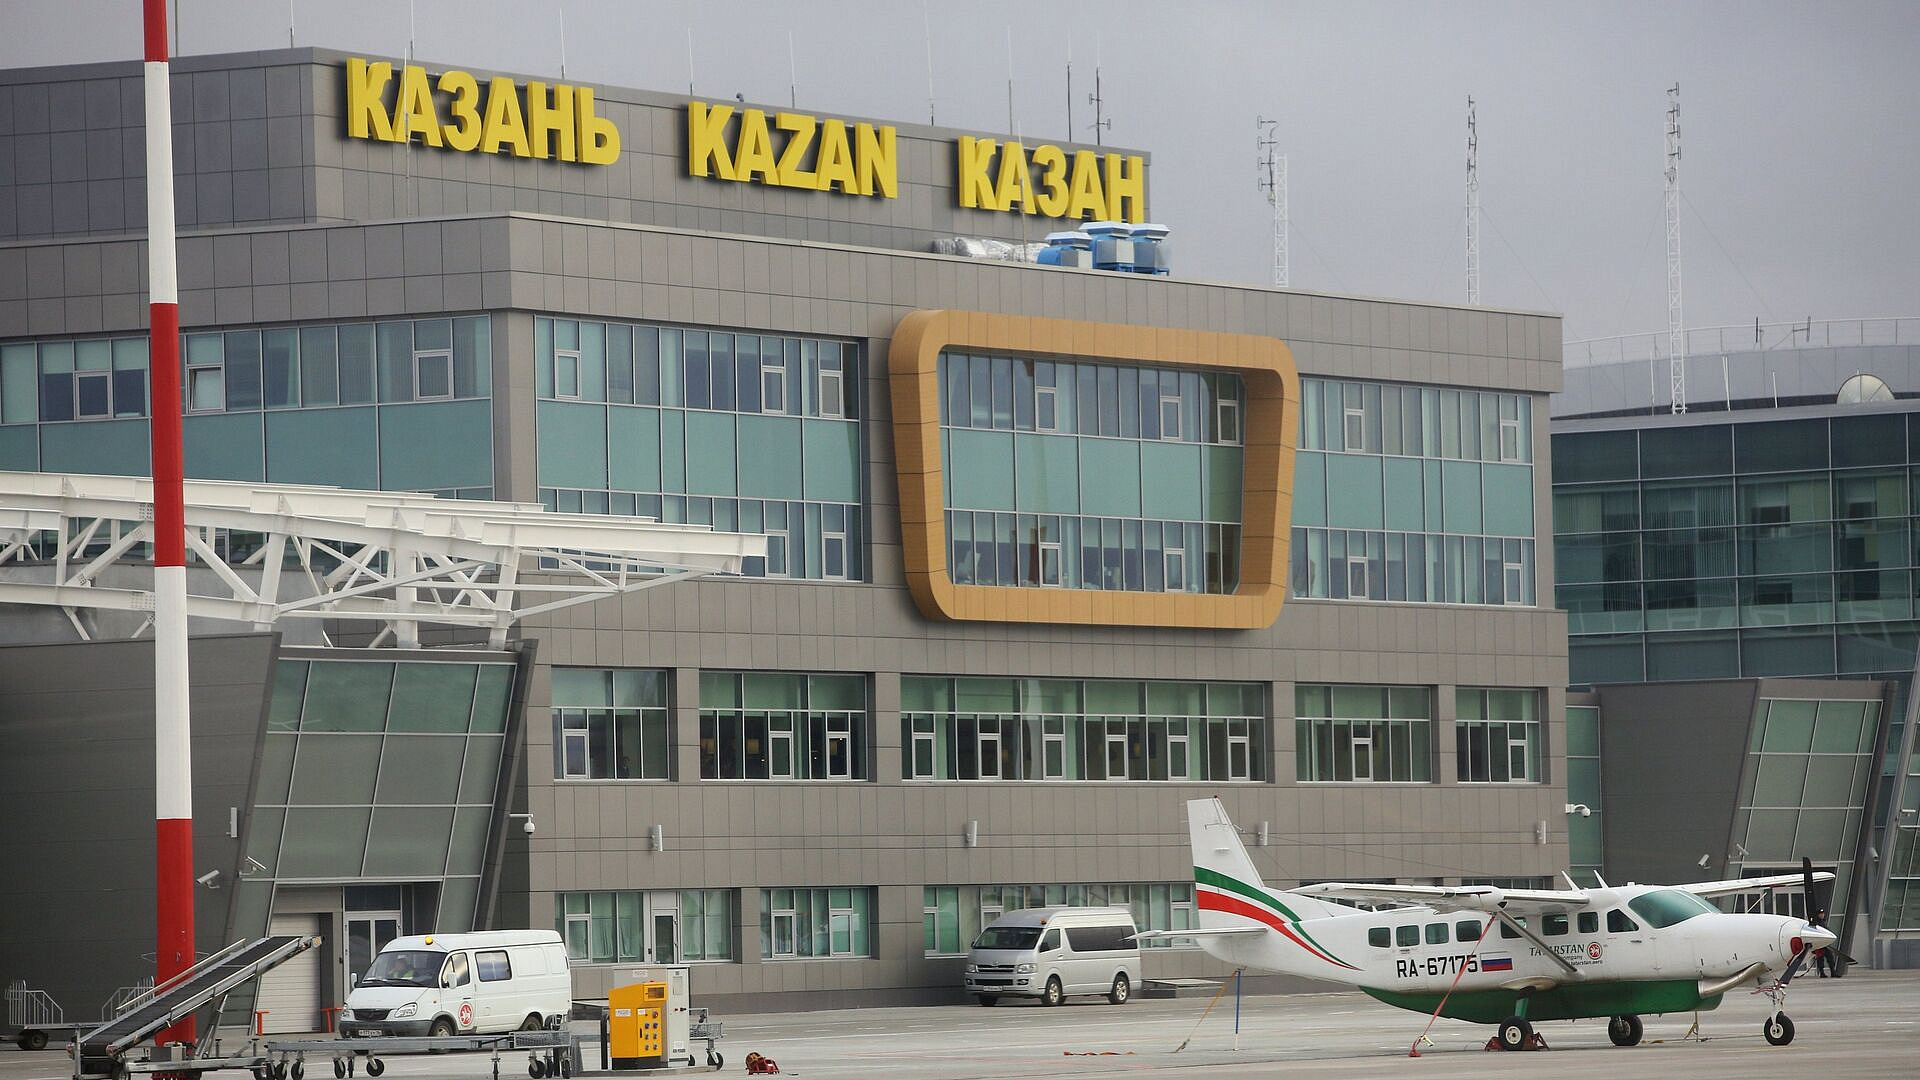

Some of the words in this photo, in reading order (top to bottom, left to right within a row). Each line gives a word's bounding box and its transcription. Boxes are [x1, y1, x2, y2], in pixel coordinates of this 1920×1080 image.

[347, 58, 620, 164] КАЗАНЬ
[688, 101, 897, 198] KAZAN
[958, 135, 1144, 224] КАЗАН
[1529, 944, 1585, 957] TARSTAN
[1397, 954, 1478, 978] RA-67175
